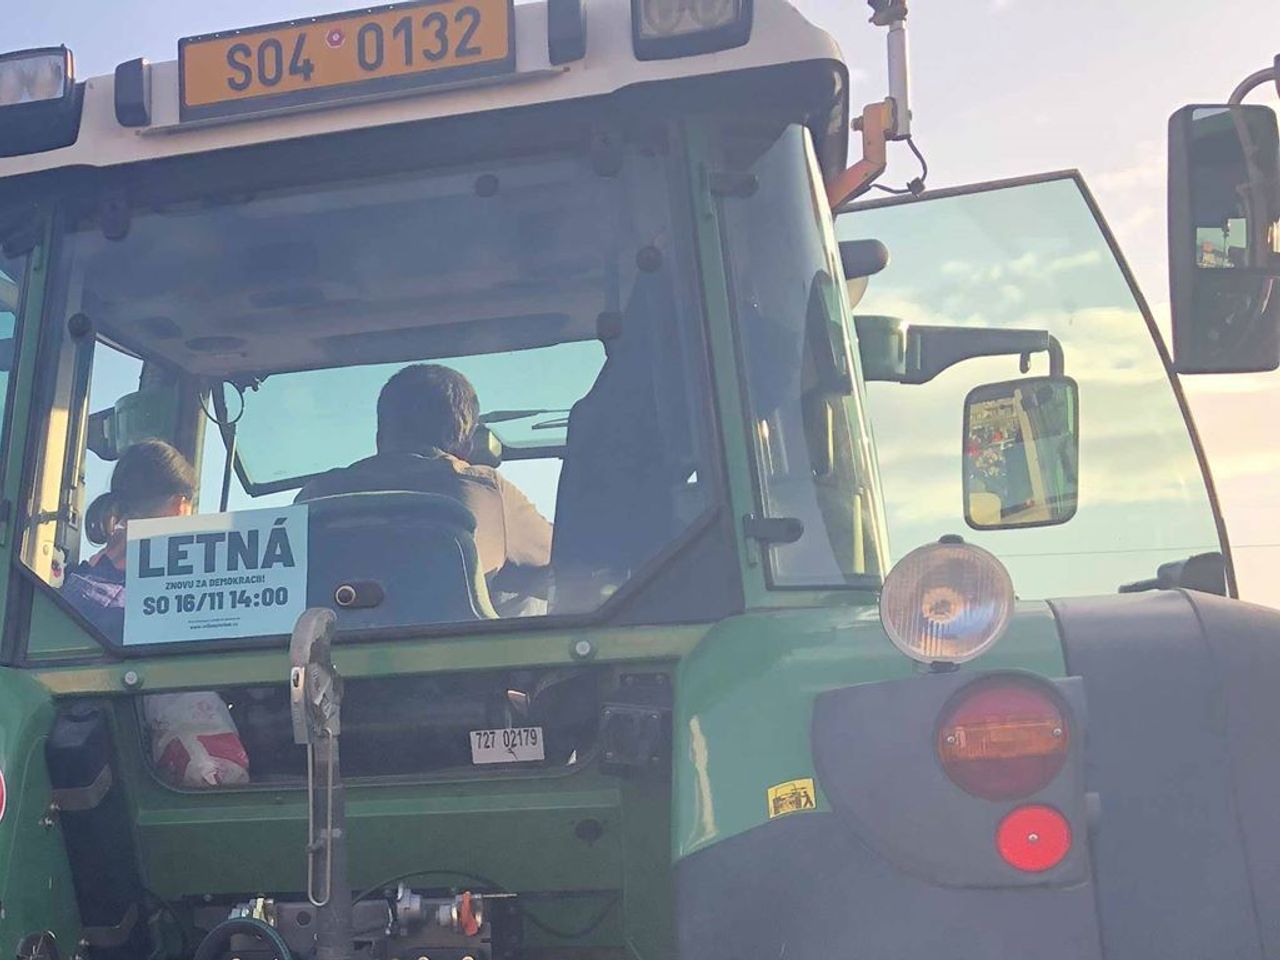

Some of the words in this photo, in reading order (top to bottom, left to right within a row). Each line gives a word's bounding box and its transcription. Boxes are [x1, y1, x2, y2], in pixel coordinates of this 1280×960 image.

[357, 6, 483, 72] 0132
[138, 517, 296, 579] LETNÁ
[165, 580, 194, 590] ZNOVU
[195, 579, 207, 588] ZA
[142, 595, 170, 616] SO
[175, 589, 224, 613] 16/11
[229, 586, 289, 610] 14:00
[476, 731, 496, 749] 727
[502, 728, 538, 748] 02179
